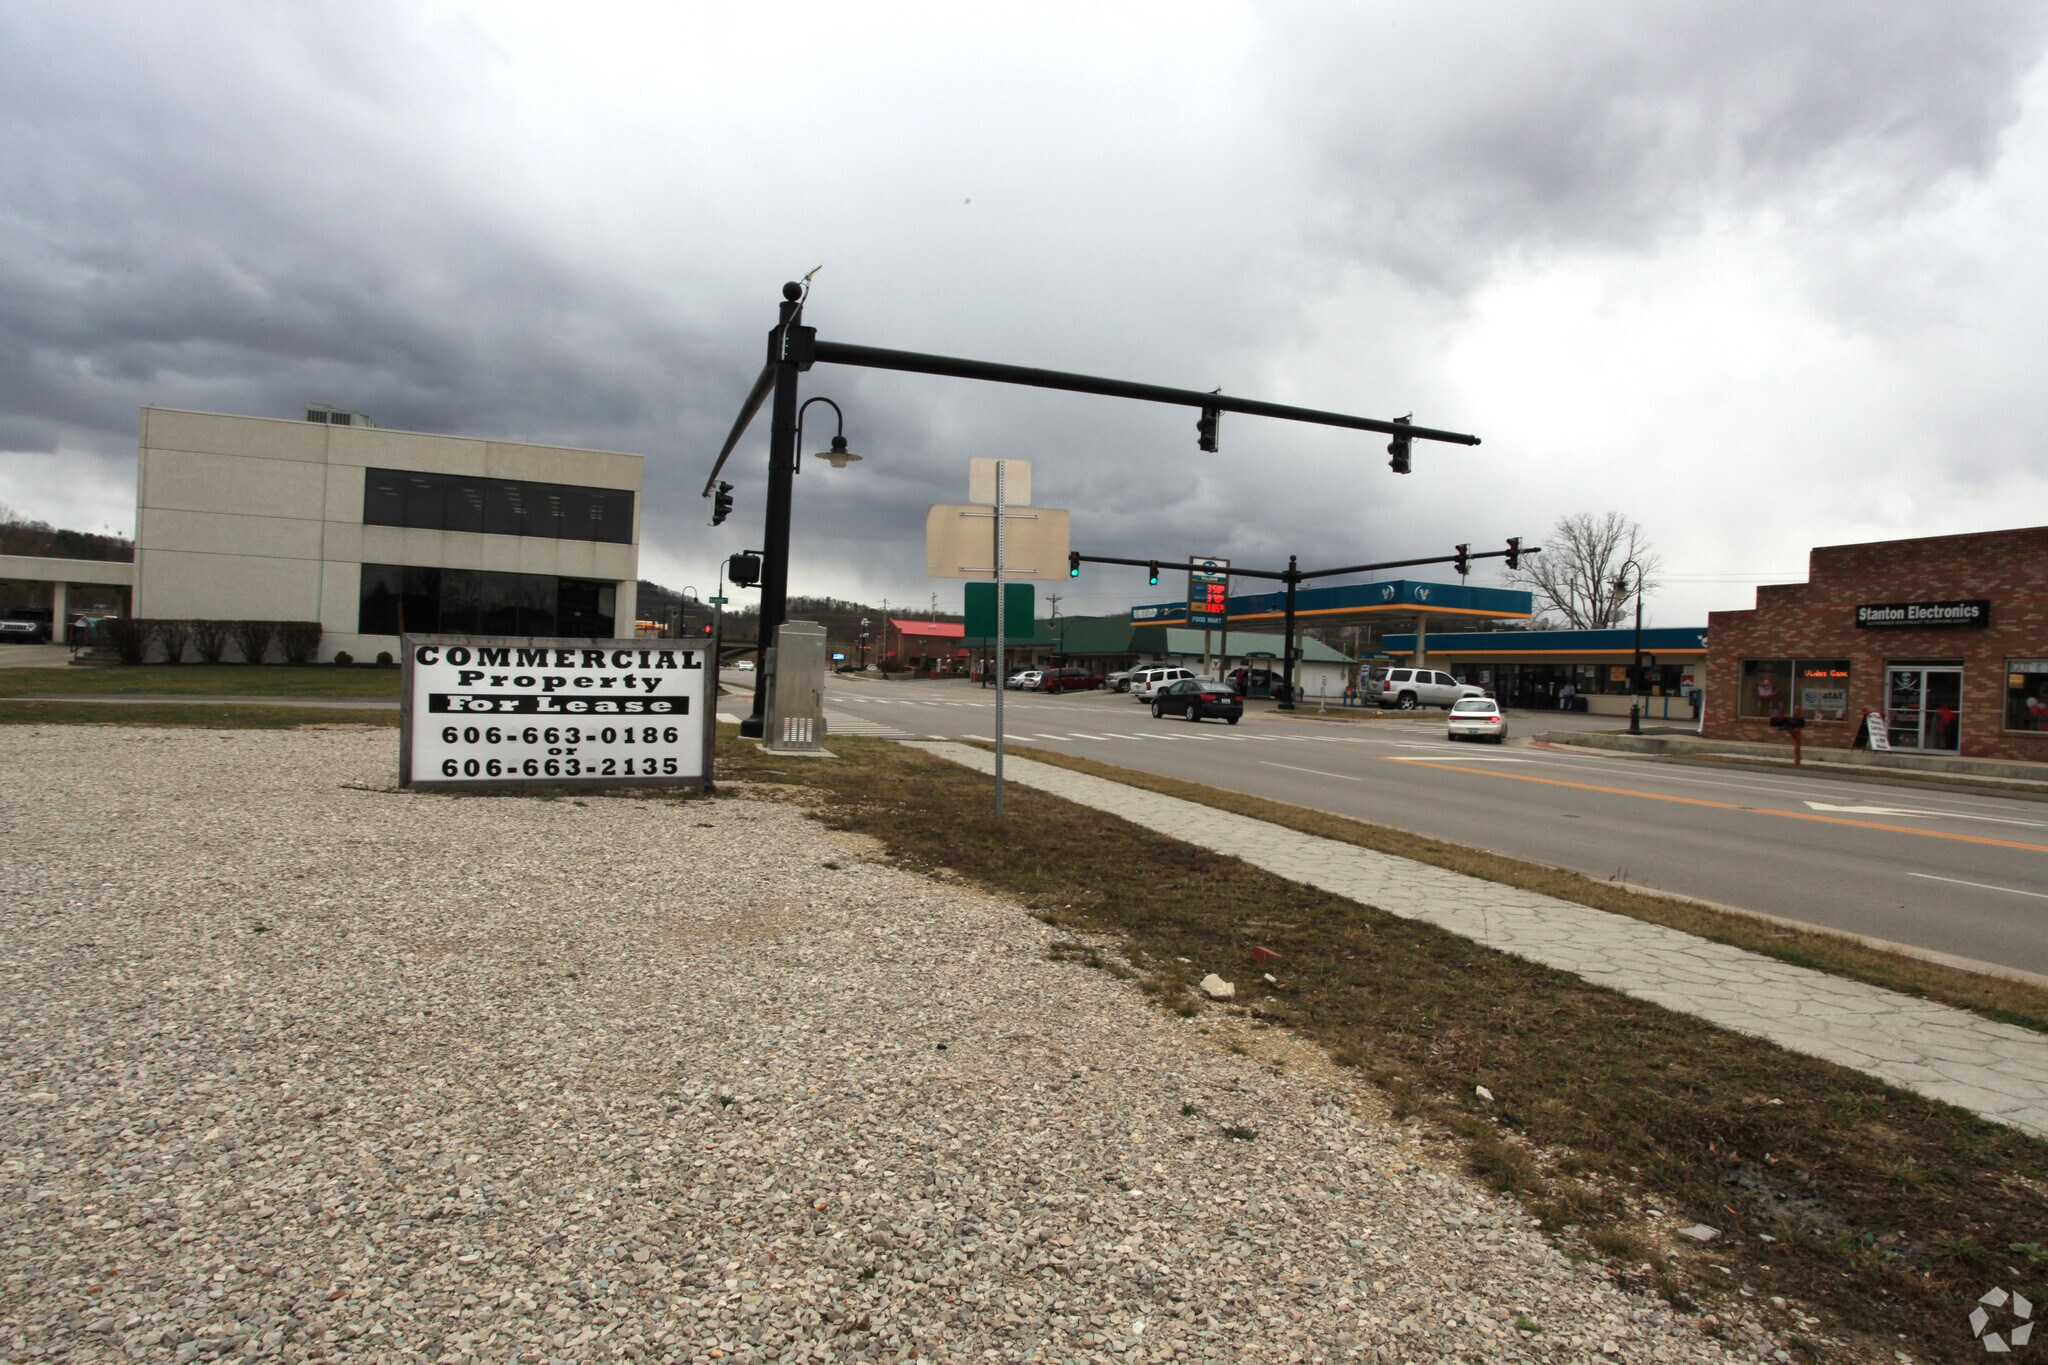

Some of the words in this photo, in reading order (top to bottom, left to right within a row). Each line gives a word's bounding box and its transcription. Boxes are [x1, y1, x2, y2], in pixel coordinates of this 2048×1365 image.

[1859, 607, 1905, 620] Stanton
[1908, 604, 1980, 619] Electronics
[415, 646, 702, 669] COMMERCIAL
[458, 670, 662, 693] Property
[447, 695, 519, 712] For
[537, 696, 673, 713] Lease
[1822, 692, 1843, 700] at&t
[442, 726, 679, 745] 606-663-0186
[547, 747, 578, 756] or
[442, 757, 678, 777] 606-663-2135
